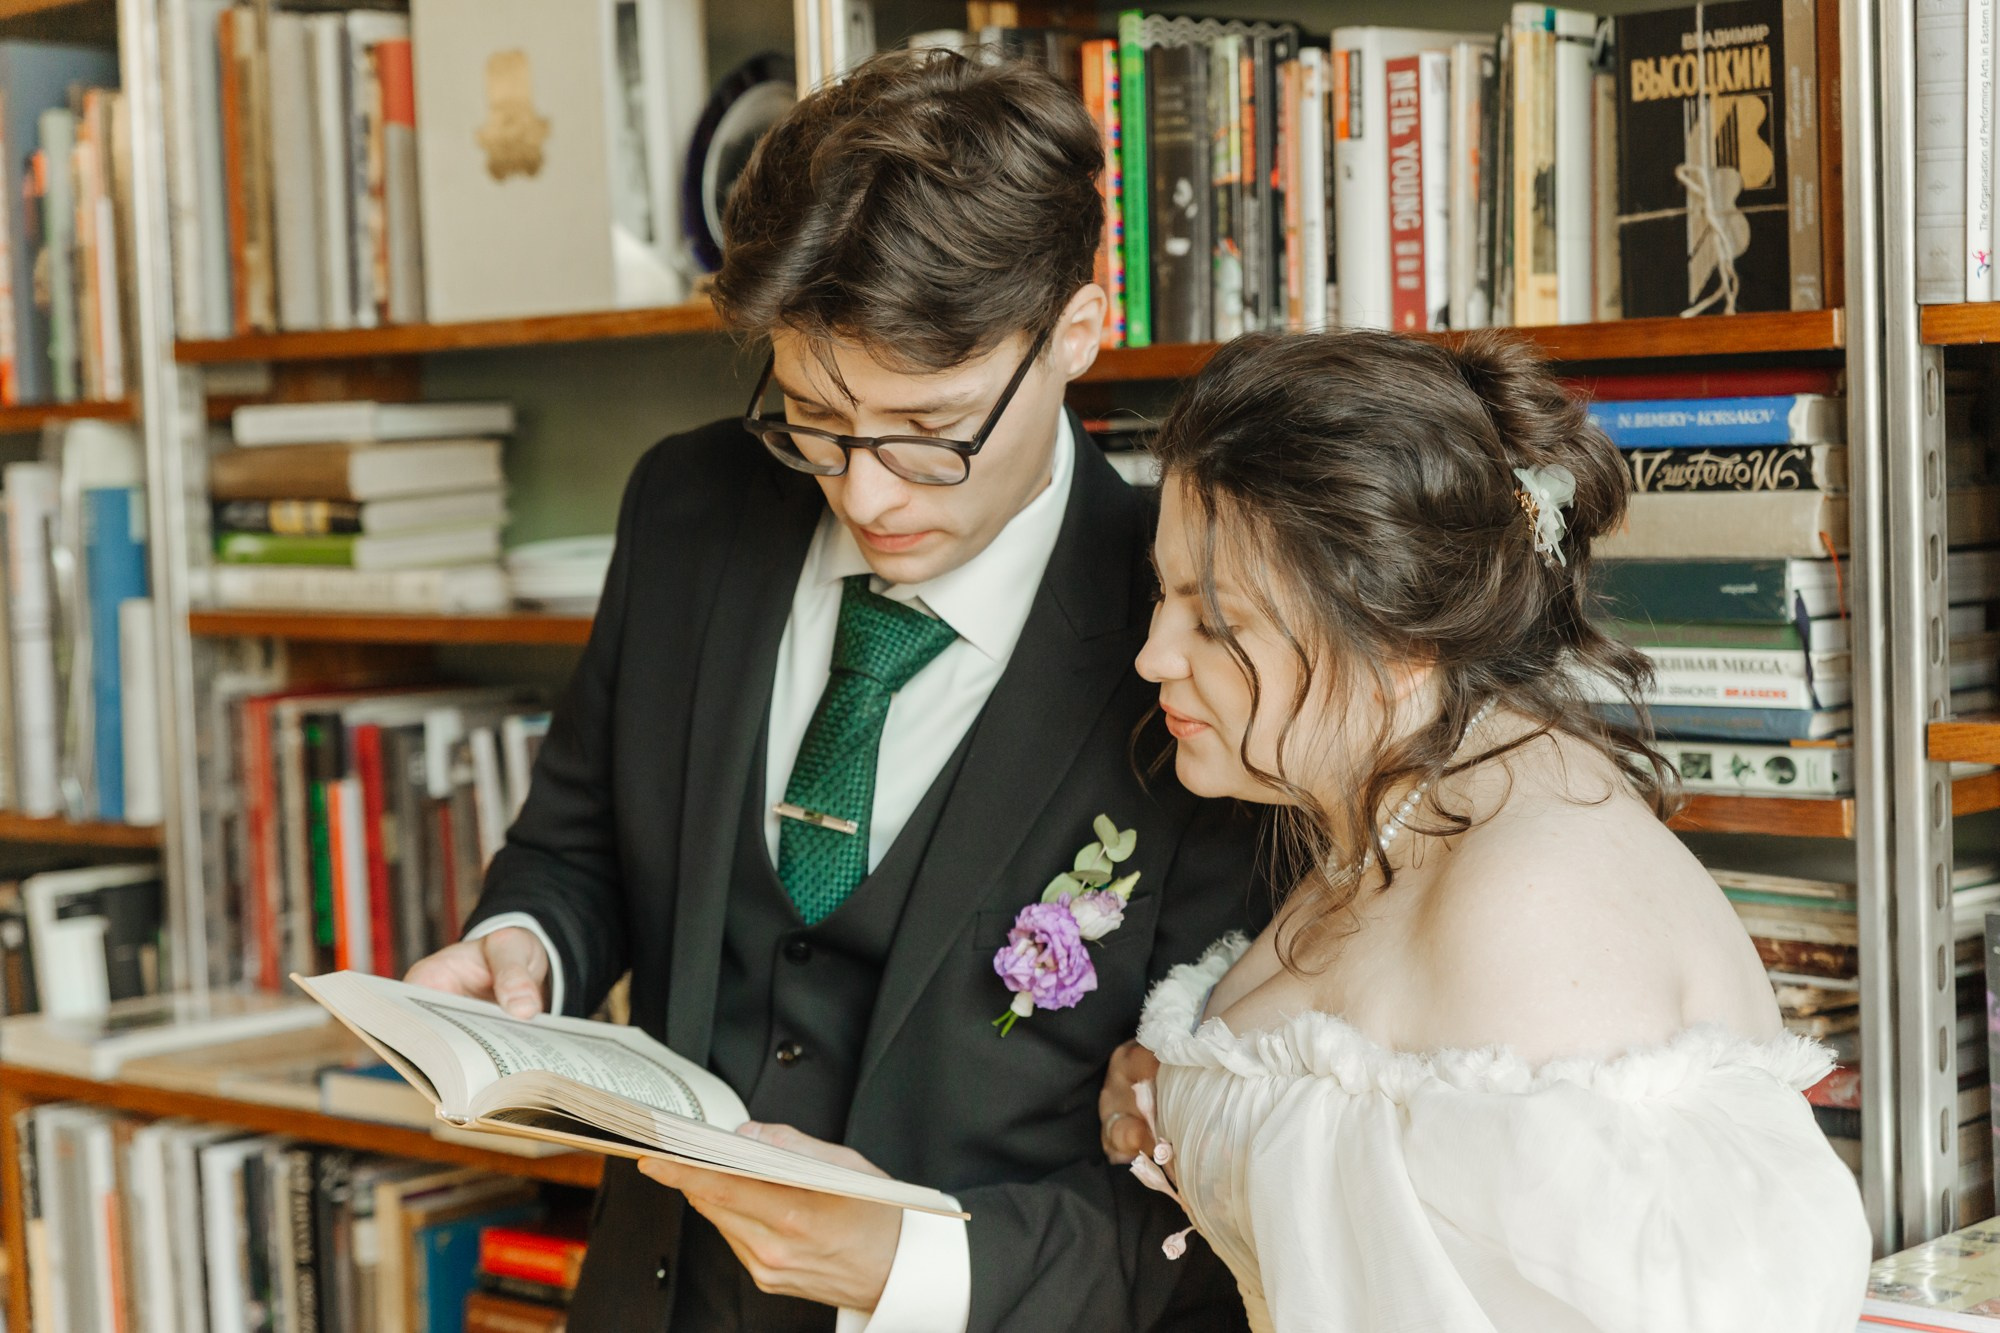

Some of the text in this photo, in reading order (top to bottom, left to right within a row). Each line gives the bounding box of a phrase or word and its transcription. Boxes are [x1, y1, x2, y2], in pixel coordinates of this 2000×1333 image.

[1980, 9, 1989, 44] Eastern
[1631, 43, 1772, 102] ВЫСОЦКИЙ
[1980, 47, 1989, 56] in
[1980, 59, 1989, 78] Arts
[1388, 70, 1418, 136] NEIL
[1979, 81, 1991, 134] Performing
[1979, 136, 1988, 147] of
[1391, 140, 1421, 231] YOUNG
[1979, 151, 1991, 211] Organisation
[1979, 213, 1988, 231] The
